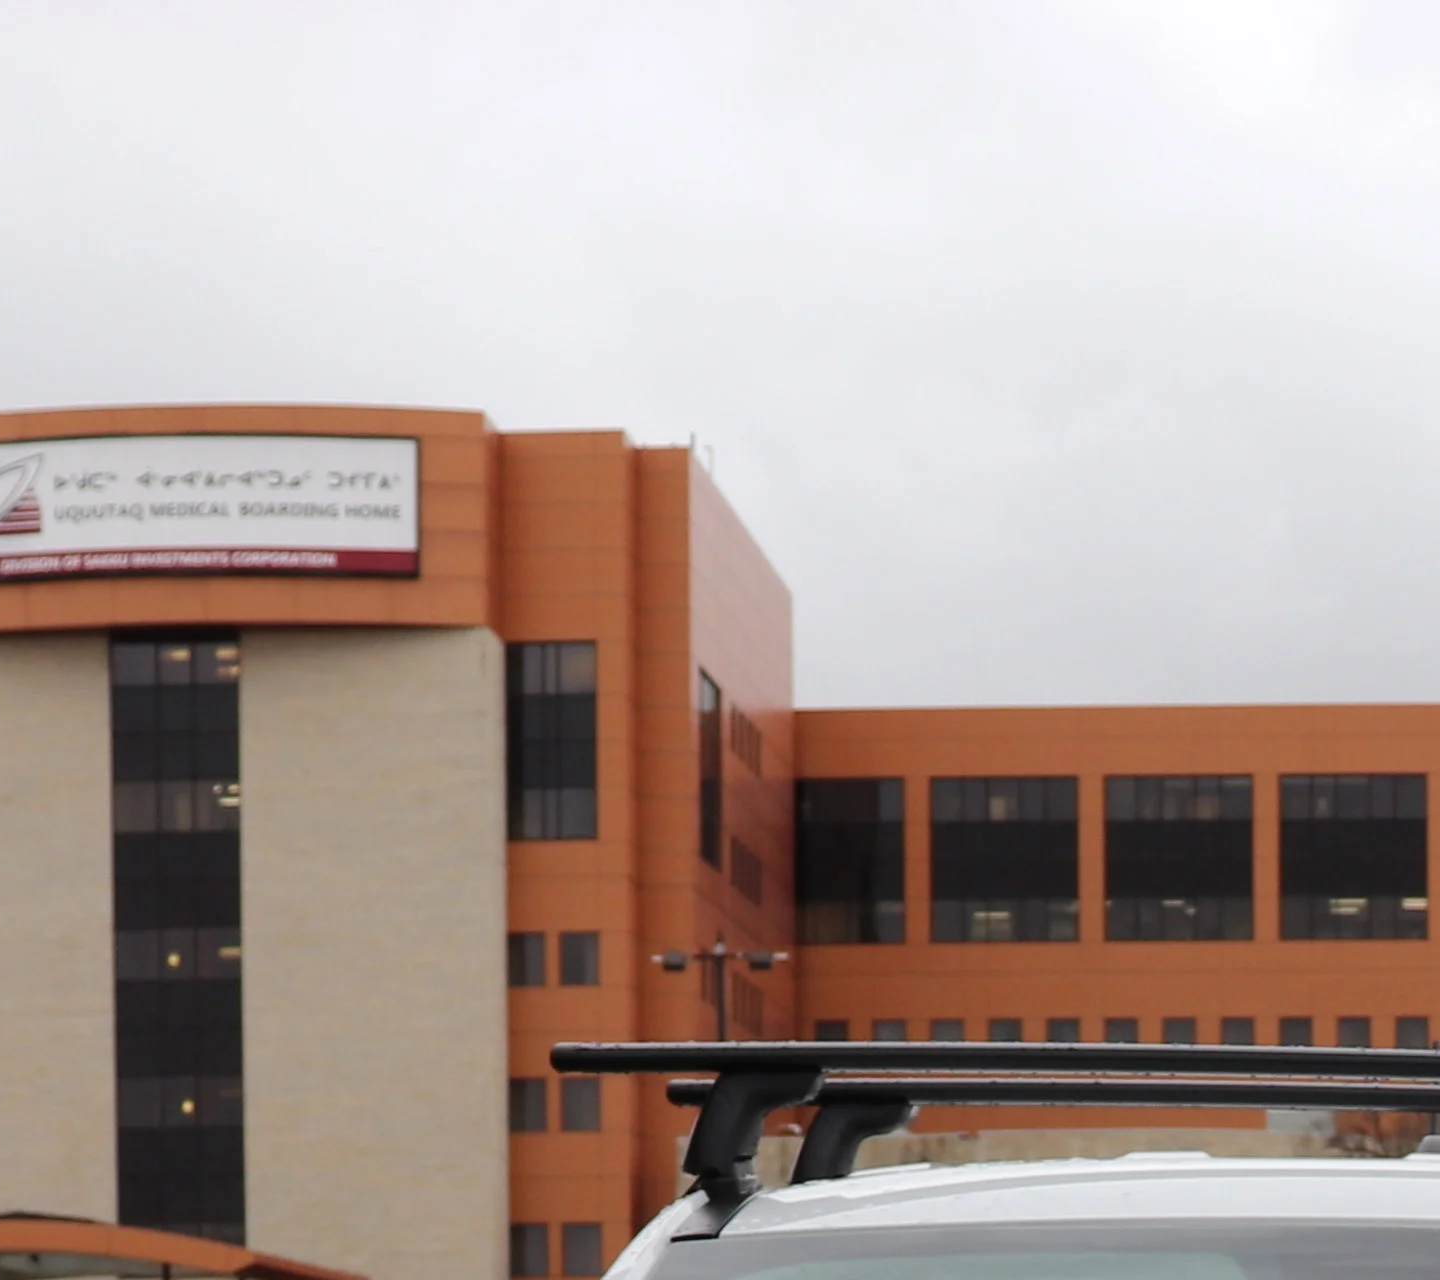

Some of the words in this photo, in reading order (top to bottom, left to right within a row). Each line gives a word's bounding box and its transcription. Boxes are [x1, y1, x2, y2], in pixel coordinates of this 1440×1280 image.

[53, 502, 145, 521] UQUUTAQ
[149, 501, 229, 518] MEDICAL
[238, 502, 339, 519] BOARDING
[344, 503, 401, 519] HOME
[0, 557, 59, 574] DIVISION
[63, 556, 81, 570] OF
[132, 551, 229, 568] INVESTMENTS
[231, 551, 338, 568] CORPORATION
